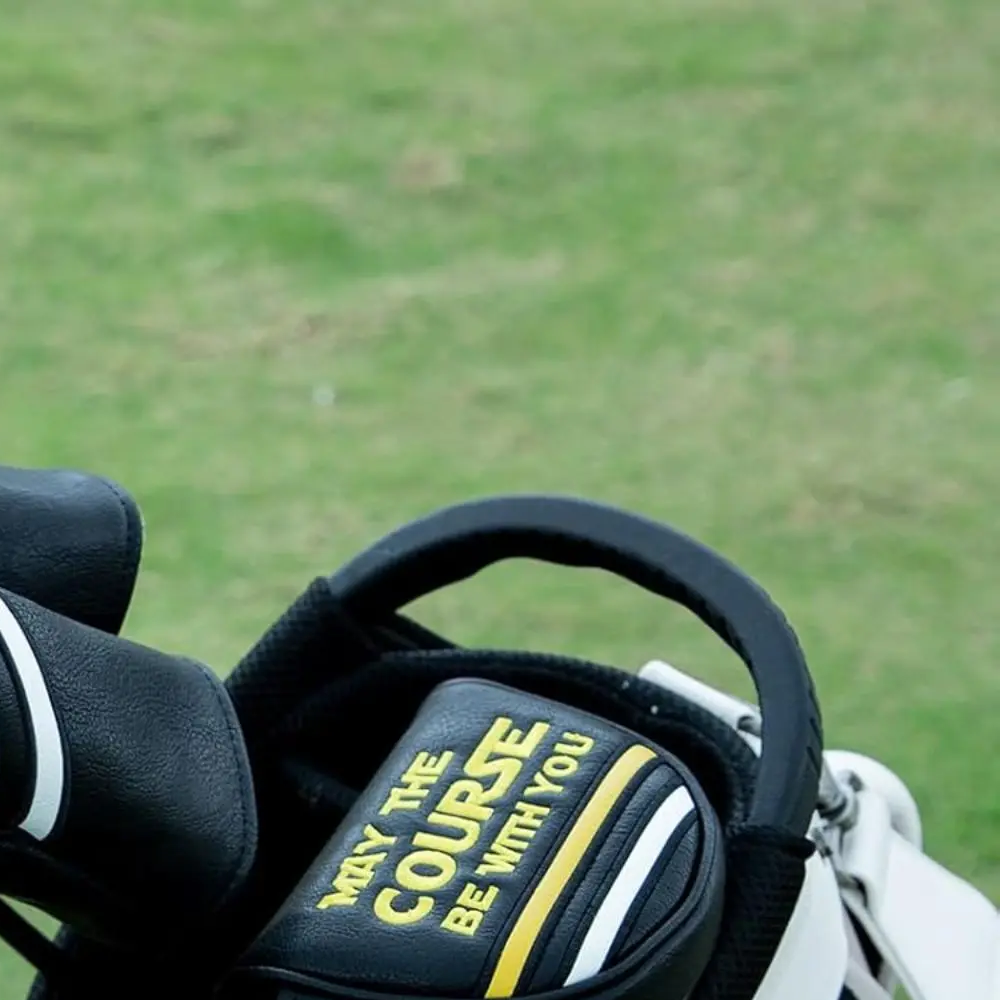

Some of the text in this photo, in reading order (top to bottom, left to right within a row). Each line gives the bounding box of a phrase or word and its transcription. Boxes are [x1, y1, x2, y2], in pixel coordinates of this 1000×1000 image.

[317, 750, 454, 910] MAY THE
[373, 717, 550, 925] COURSE
[441, 731, 596, 936] BE WITH YOU
